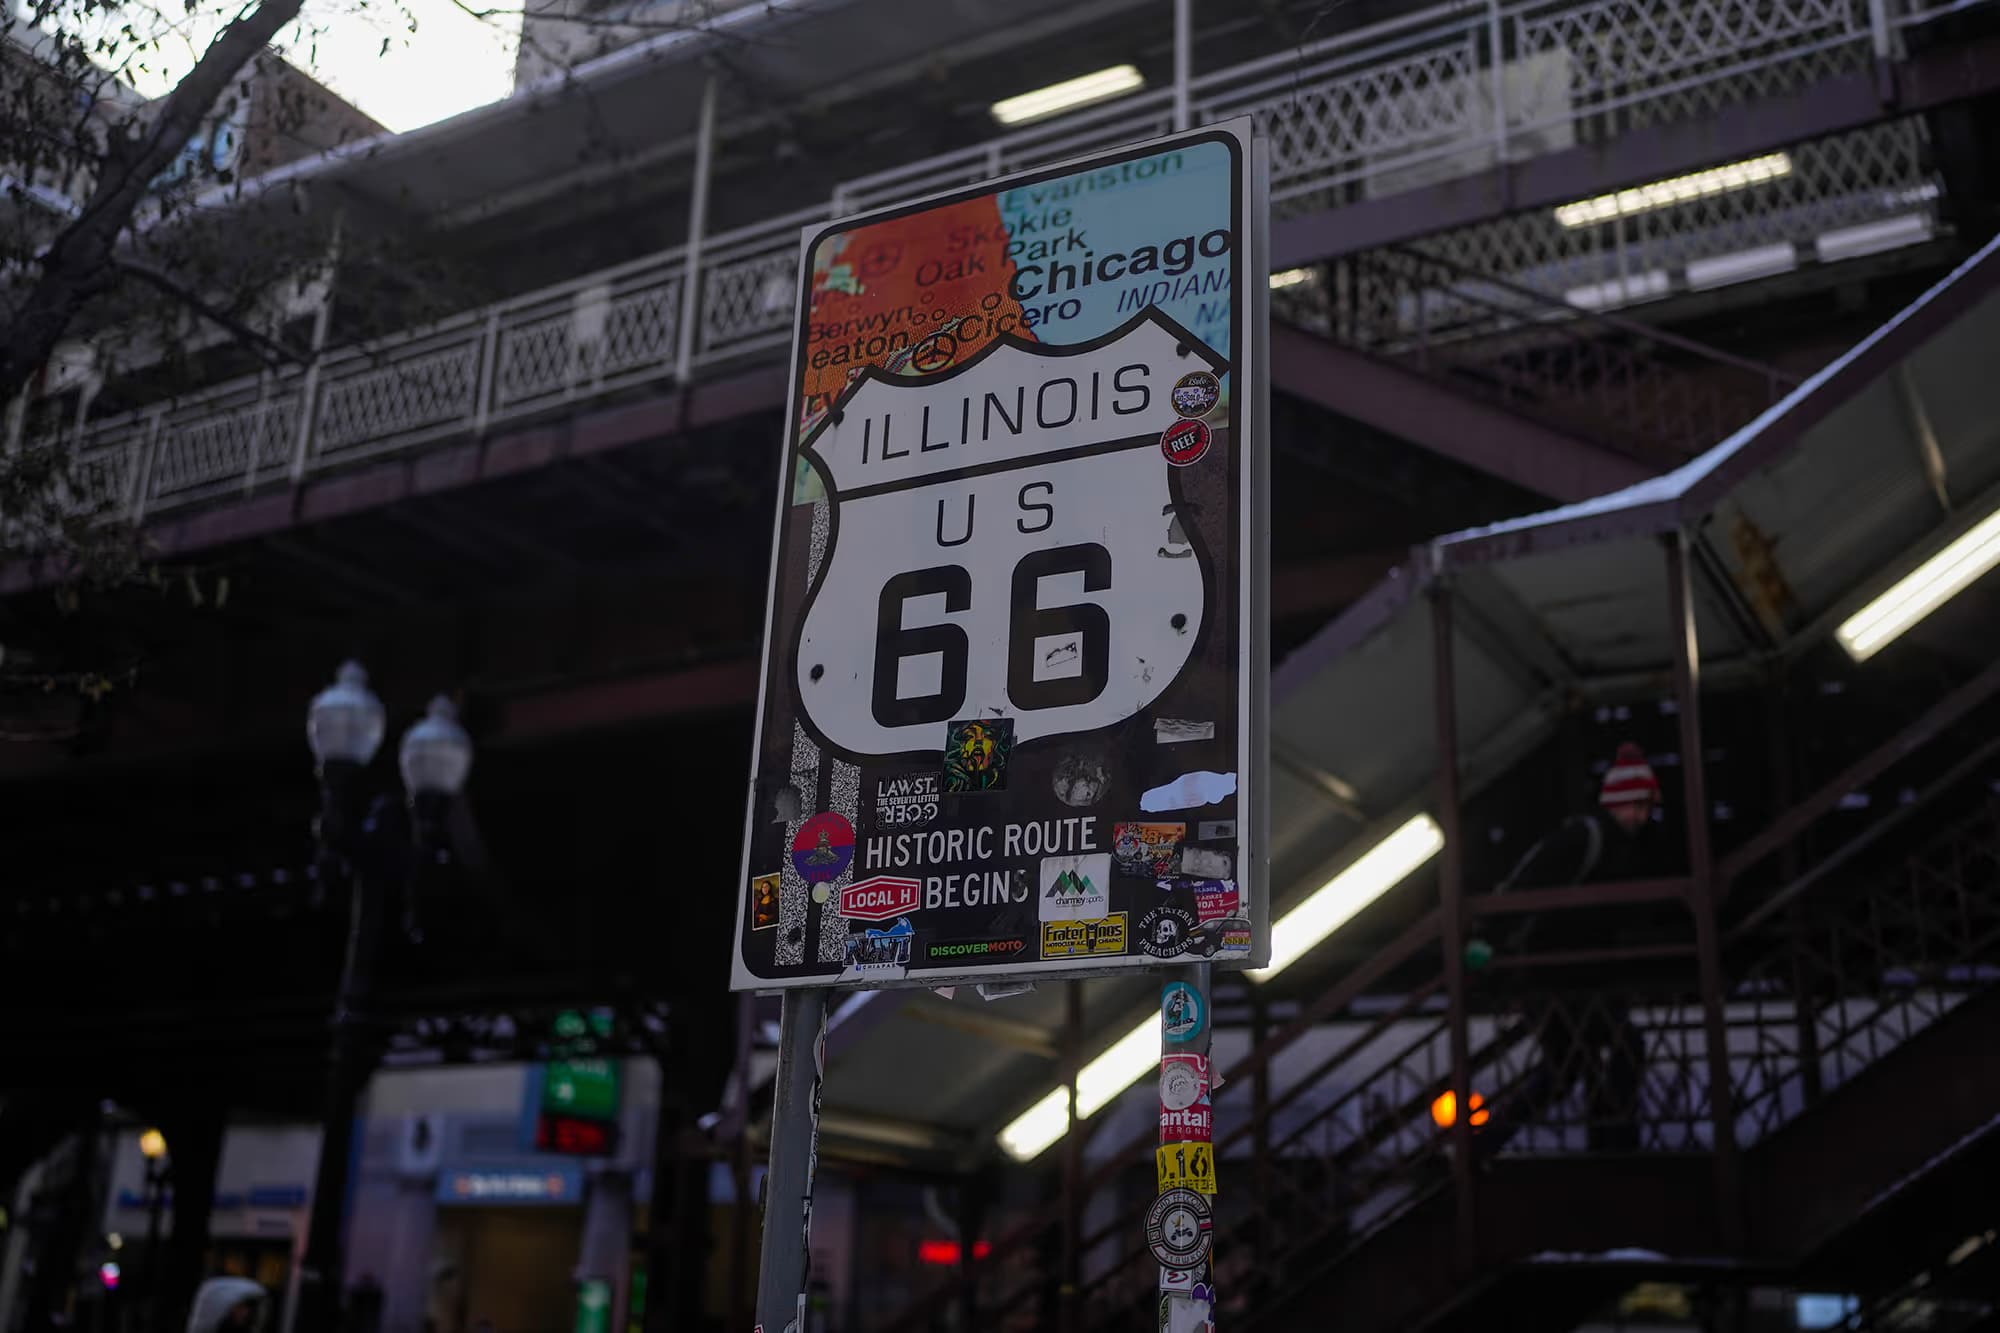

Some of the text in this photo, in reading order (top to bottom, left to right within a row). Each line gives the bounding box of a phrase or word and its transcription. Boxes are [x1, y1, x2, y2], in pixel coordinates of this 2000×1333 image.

[1004, 153, 1184, 213] Evanston
[915, 227, 1088, 287] Oak Park
[1008, 229, 1232, 301] Chicago
[806, 304, 914, 344] Berwyn
[956, 298, 1082, 342] Cicero
[811, 331, 911, 370] eaton
[861, 363, 1151, 465] ILLINOIS
[1170, 432, 1197, 453] REEF
[871, 542, 1112, 729] 66
[865, 816, 1097, 870] HISTORIC ROUTE
[848, 888, 911, 909] LOCAL H
[925, 869, 1029, 909] BEGINS
[1138, 907, 1194, 929] THE TAVERN
[1138, 937, 1194, 957] PREACHERS
